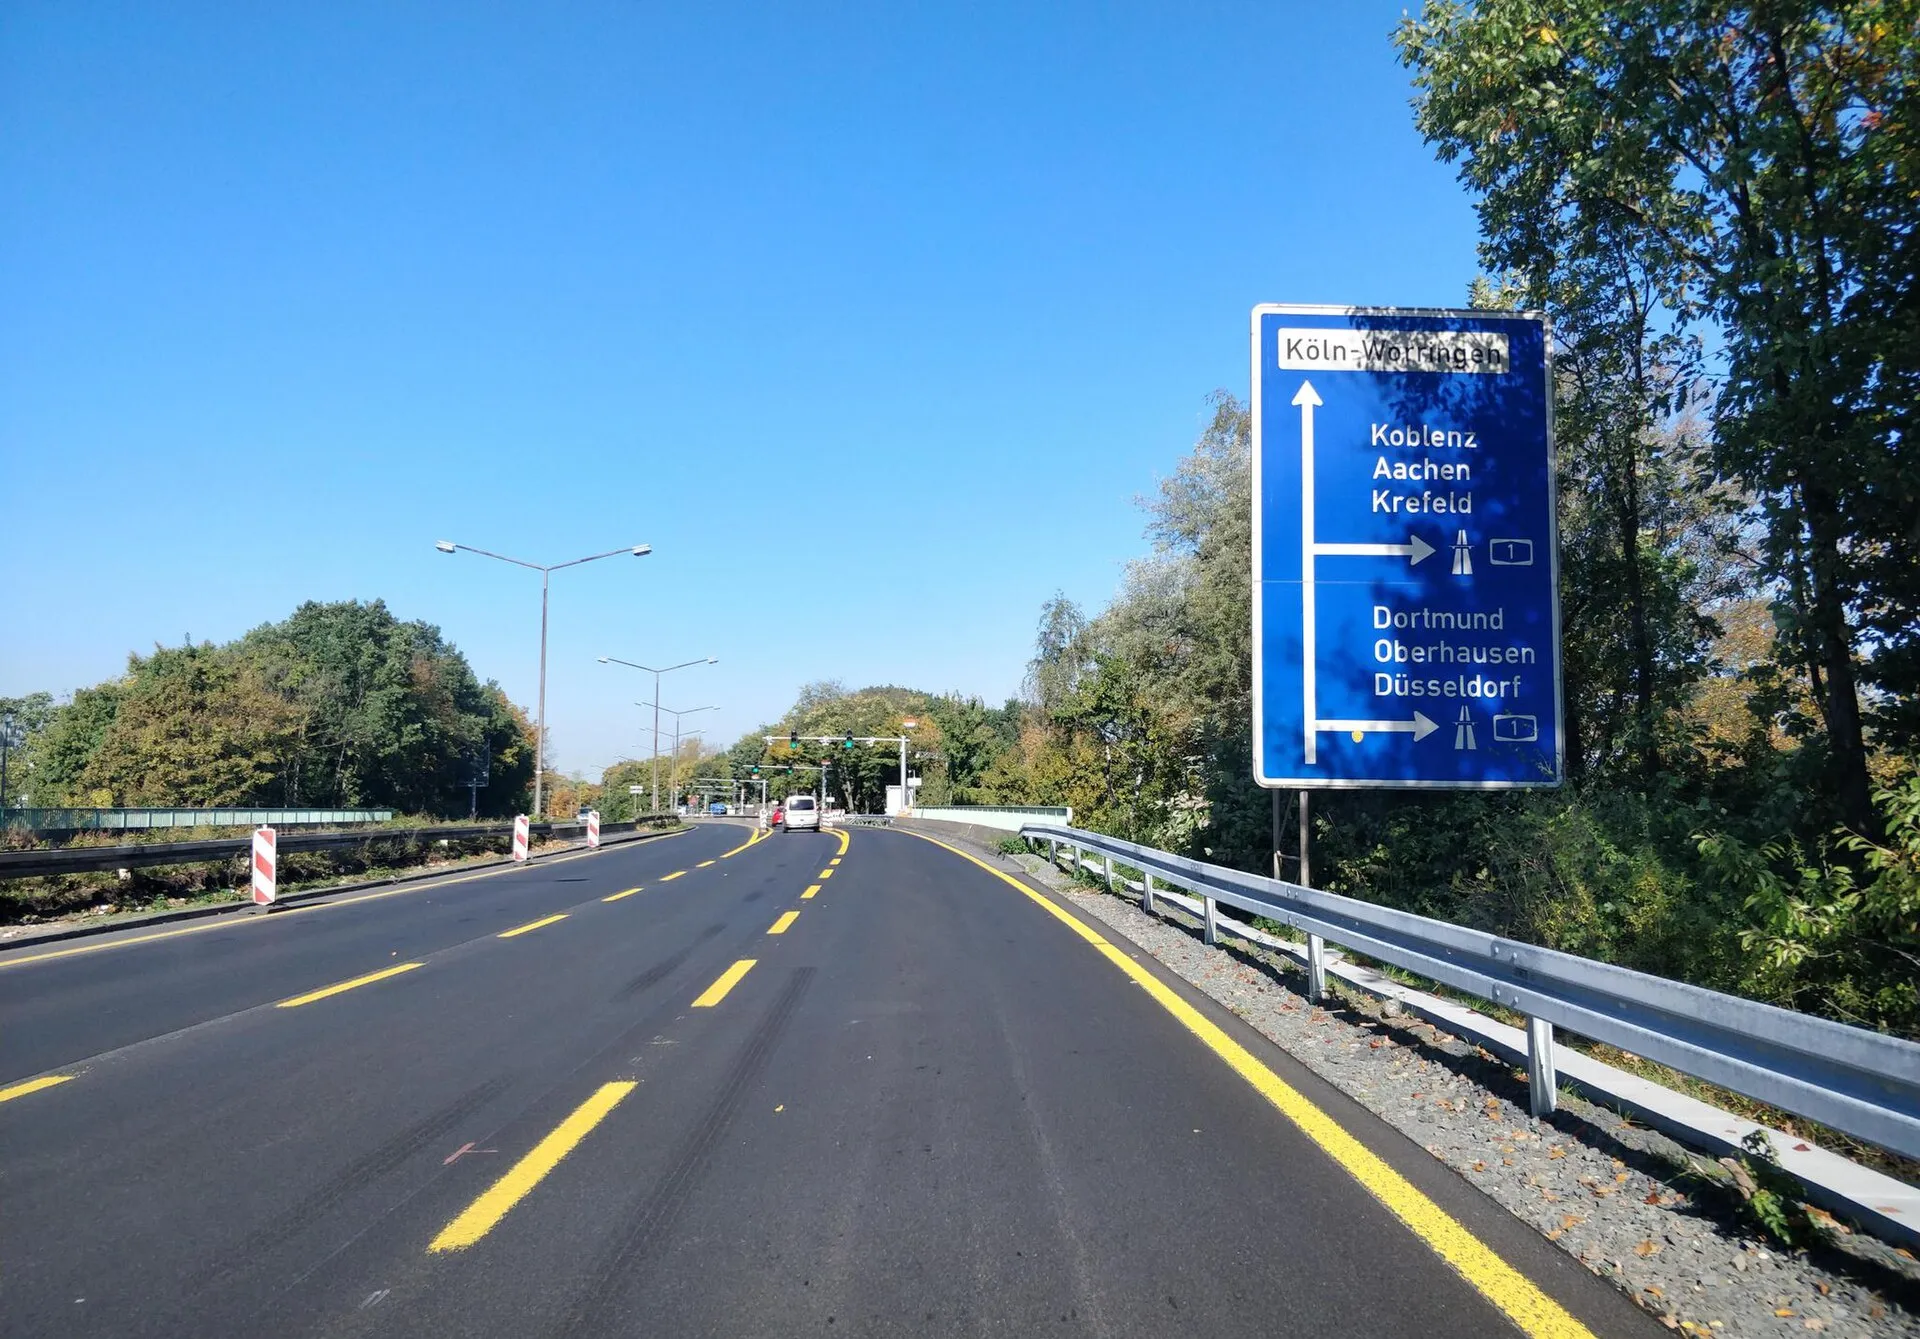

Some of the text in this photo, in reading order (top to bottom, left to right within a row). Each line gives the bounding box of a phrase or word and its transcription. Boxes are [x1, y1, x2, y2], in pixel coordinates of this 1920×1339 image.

[1286, 338, 1501, 369] Köln-Worringen
[1371, 423, 1477, 449] Koblenz
[1373, 456, 1470, 481] Aachen
[1372, 490, 1472, 514] Krefeld
[1373, 605, 1504, 630] Dortmund
[1374, 638, 1536, 664] Oberhausen
[1375, 672, 1521, 698] Düsseldorf
